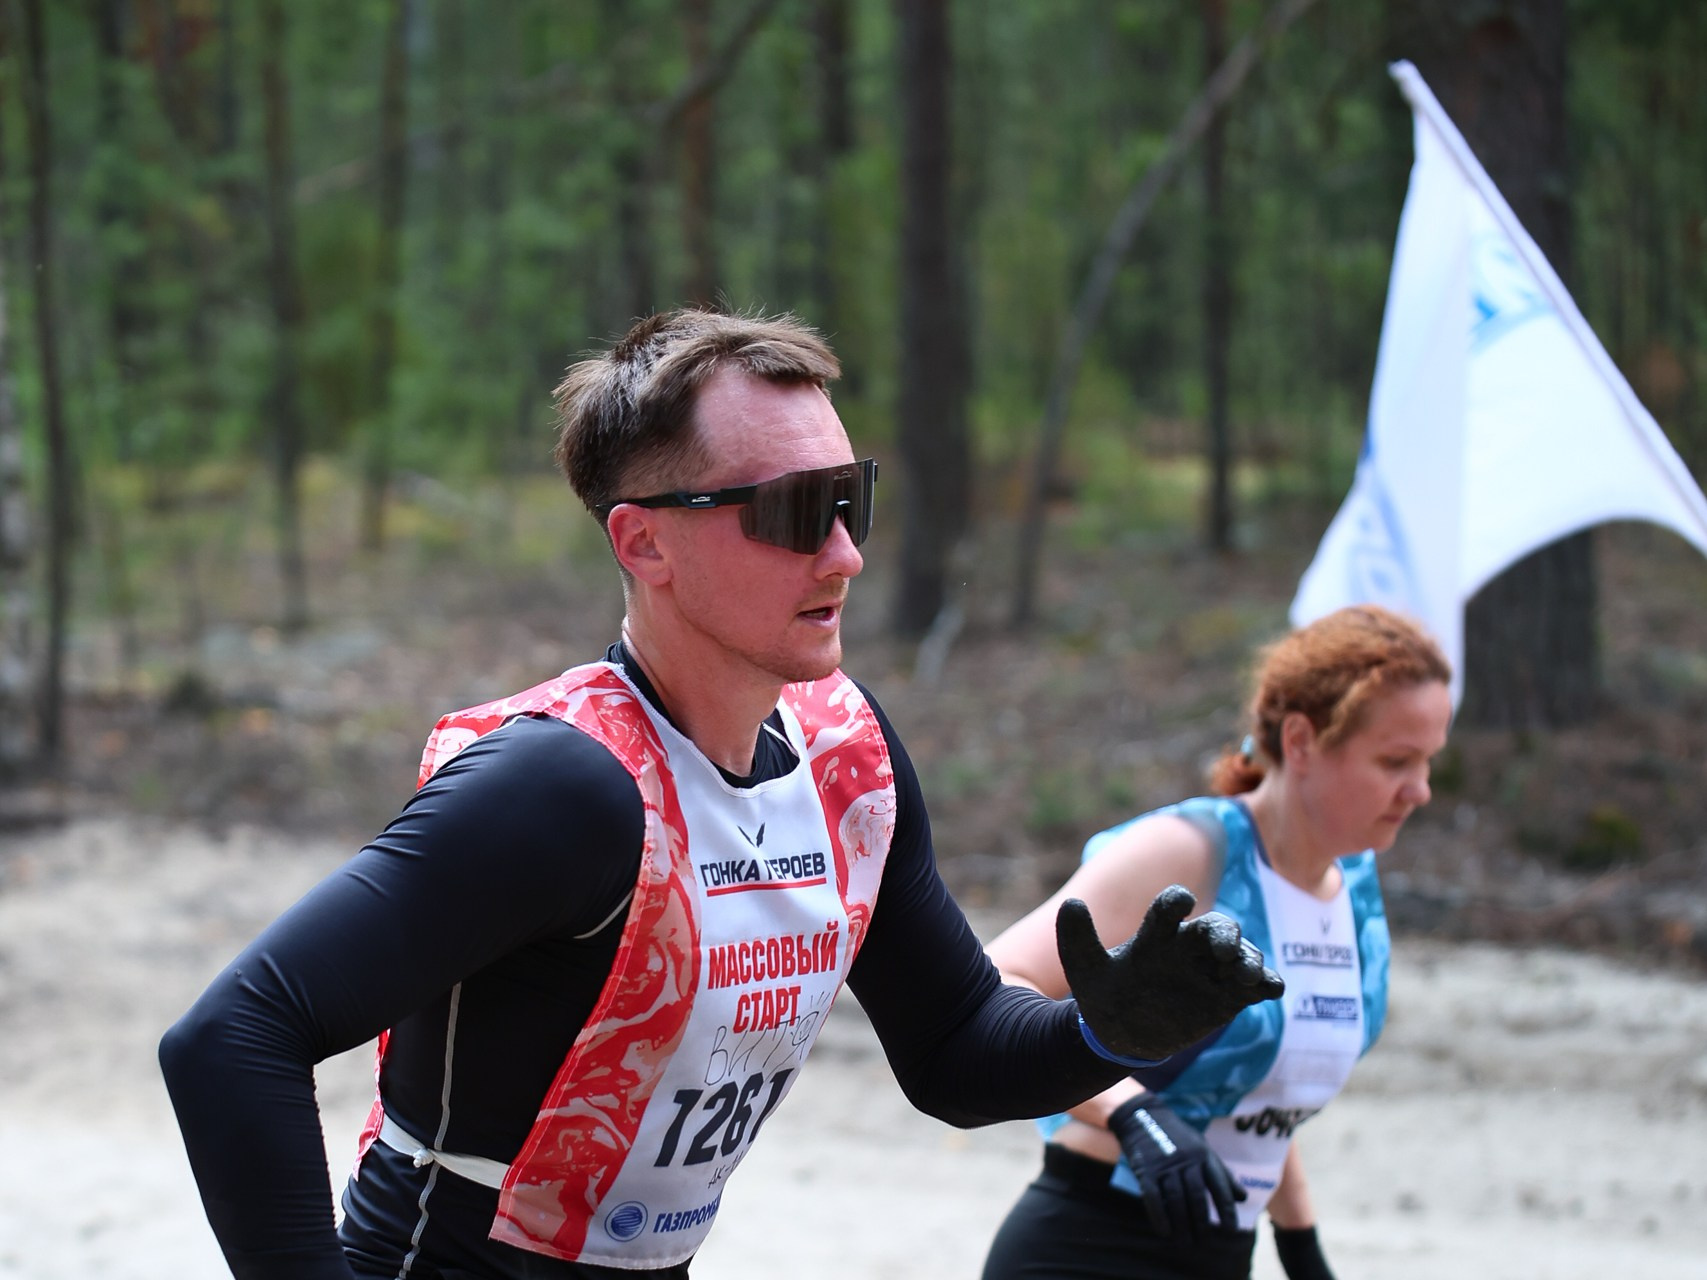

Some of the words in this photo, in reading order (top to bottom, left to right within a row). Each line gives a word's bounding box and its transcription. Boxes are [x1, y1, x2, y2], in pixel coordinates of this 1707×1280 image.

[700, 859, 761, 887] ГОНКА
[763, 851, 826, 881] ГЕРОЕВ
[708, 921, 839, 990] МАССОВЫЙ
[733, 985, 801, 1034] СТАРТ
[653, 1067, 795, 1168] 1261
[653, 1193, 721, 1233] ГАЗПРОМБ
